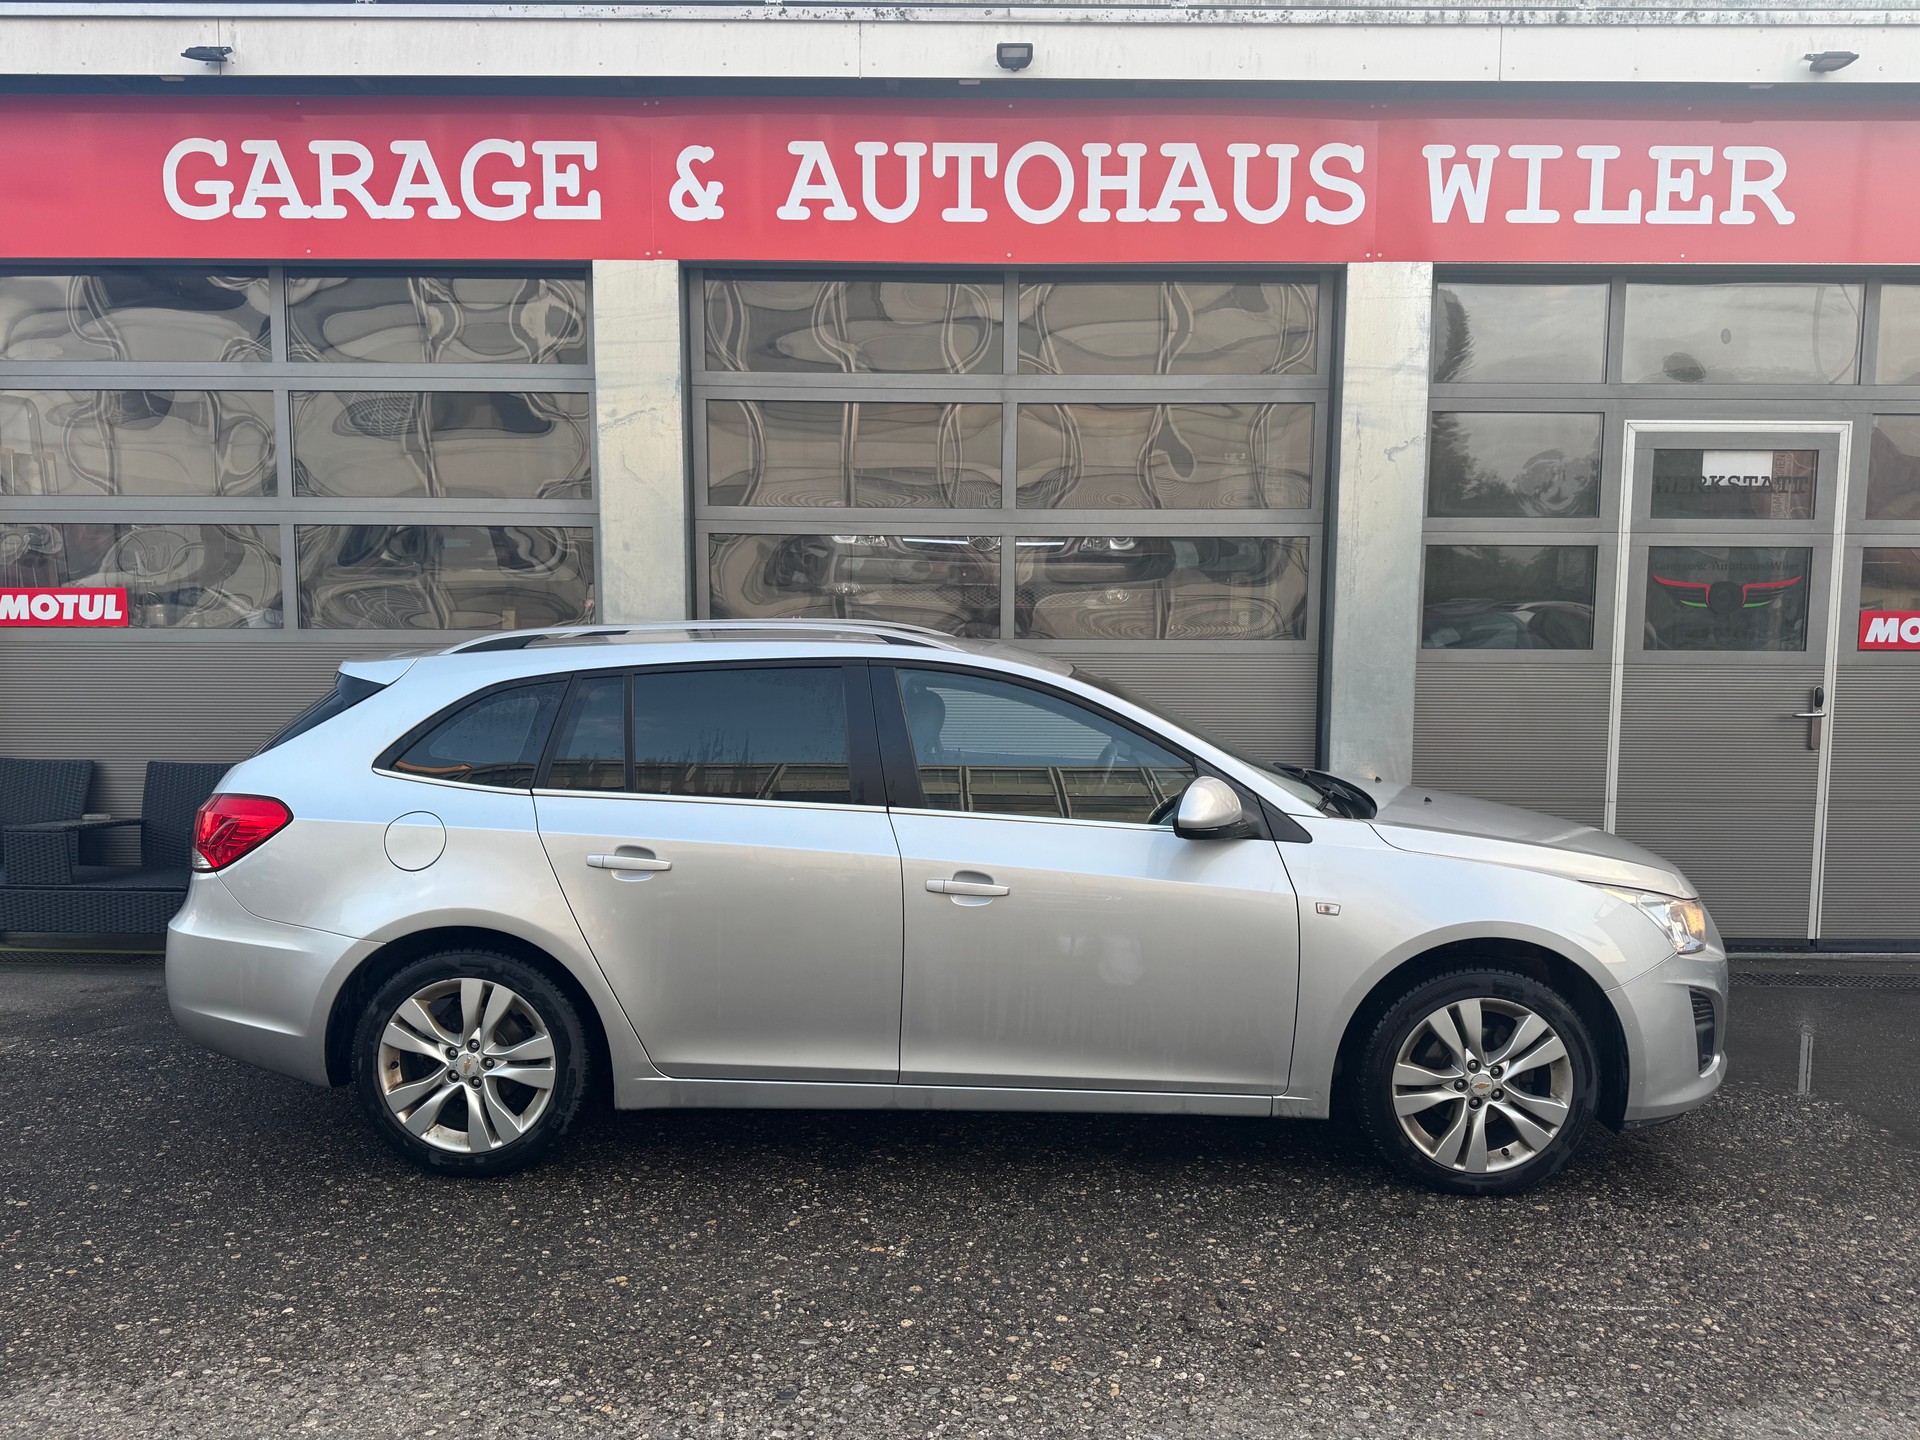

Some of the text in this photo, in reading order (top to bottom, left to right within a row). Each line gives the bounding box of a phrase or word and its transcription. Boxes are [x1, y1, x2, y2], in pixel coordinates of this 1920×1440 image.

[163, 138, 1796, 225] GARAGE & AUTOHAUS WILER
[0, 594, 122, 620] MOTUL
